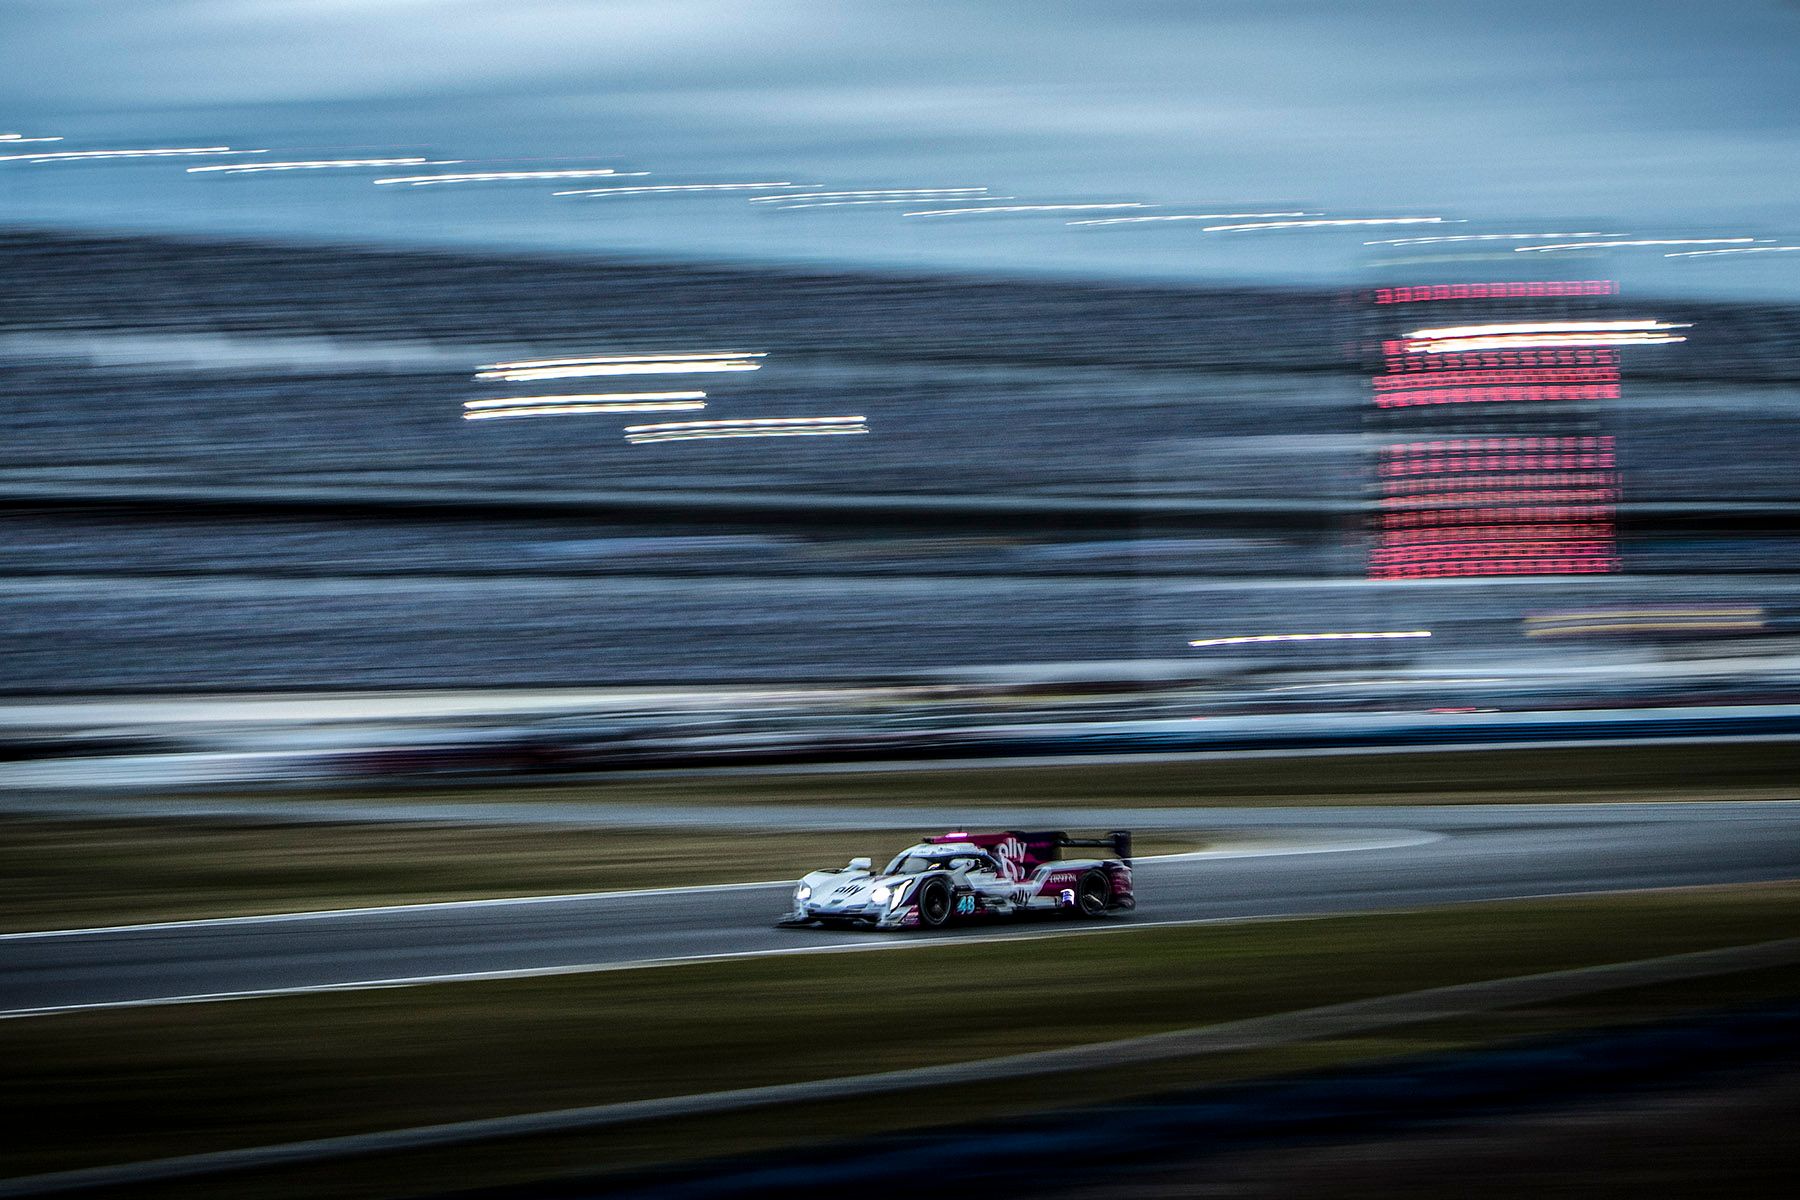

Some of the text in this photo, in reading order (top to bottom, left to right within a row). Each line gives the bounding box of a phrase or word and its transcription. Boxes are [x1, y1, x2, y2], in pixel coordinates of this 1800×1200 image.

[999, 838, 1027, 863] ally
[833, 885, 865, 897] ally
[1010, 889, 1031, 907] ally
[957, 896, 975, 914] 48
